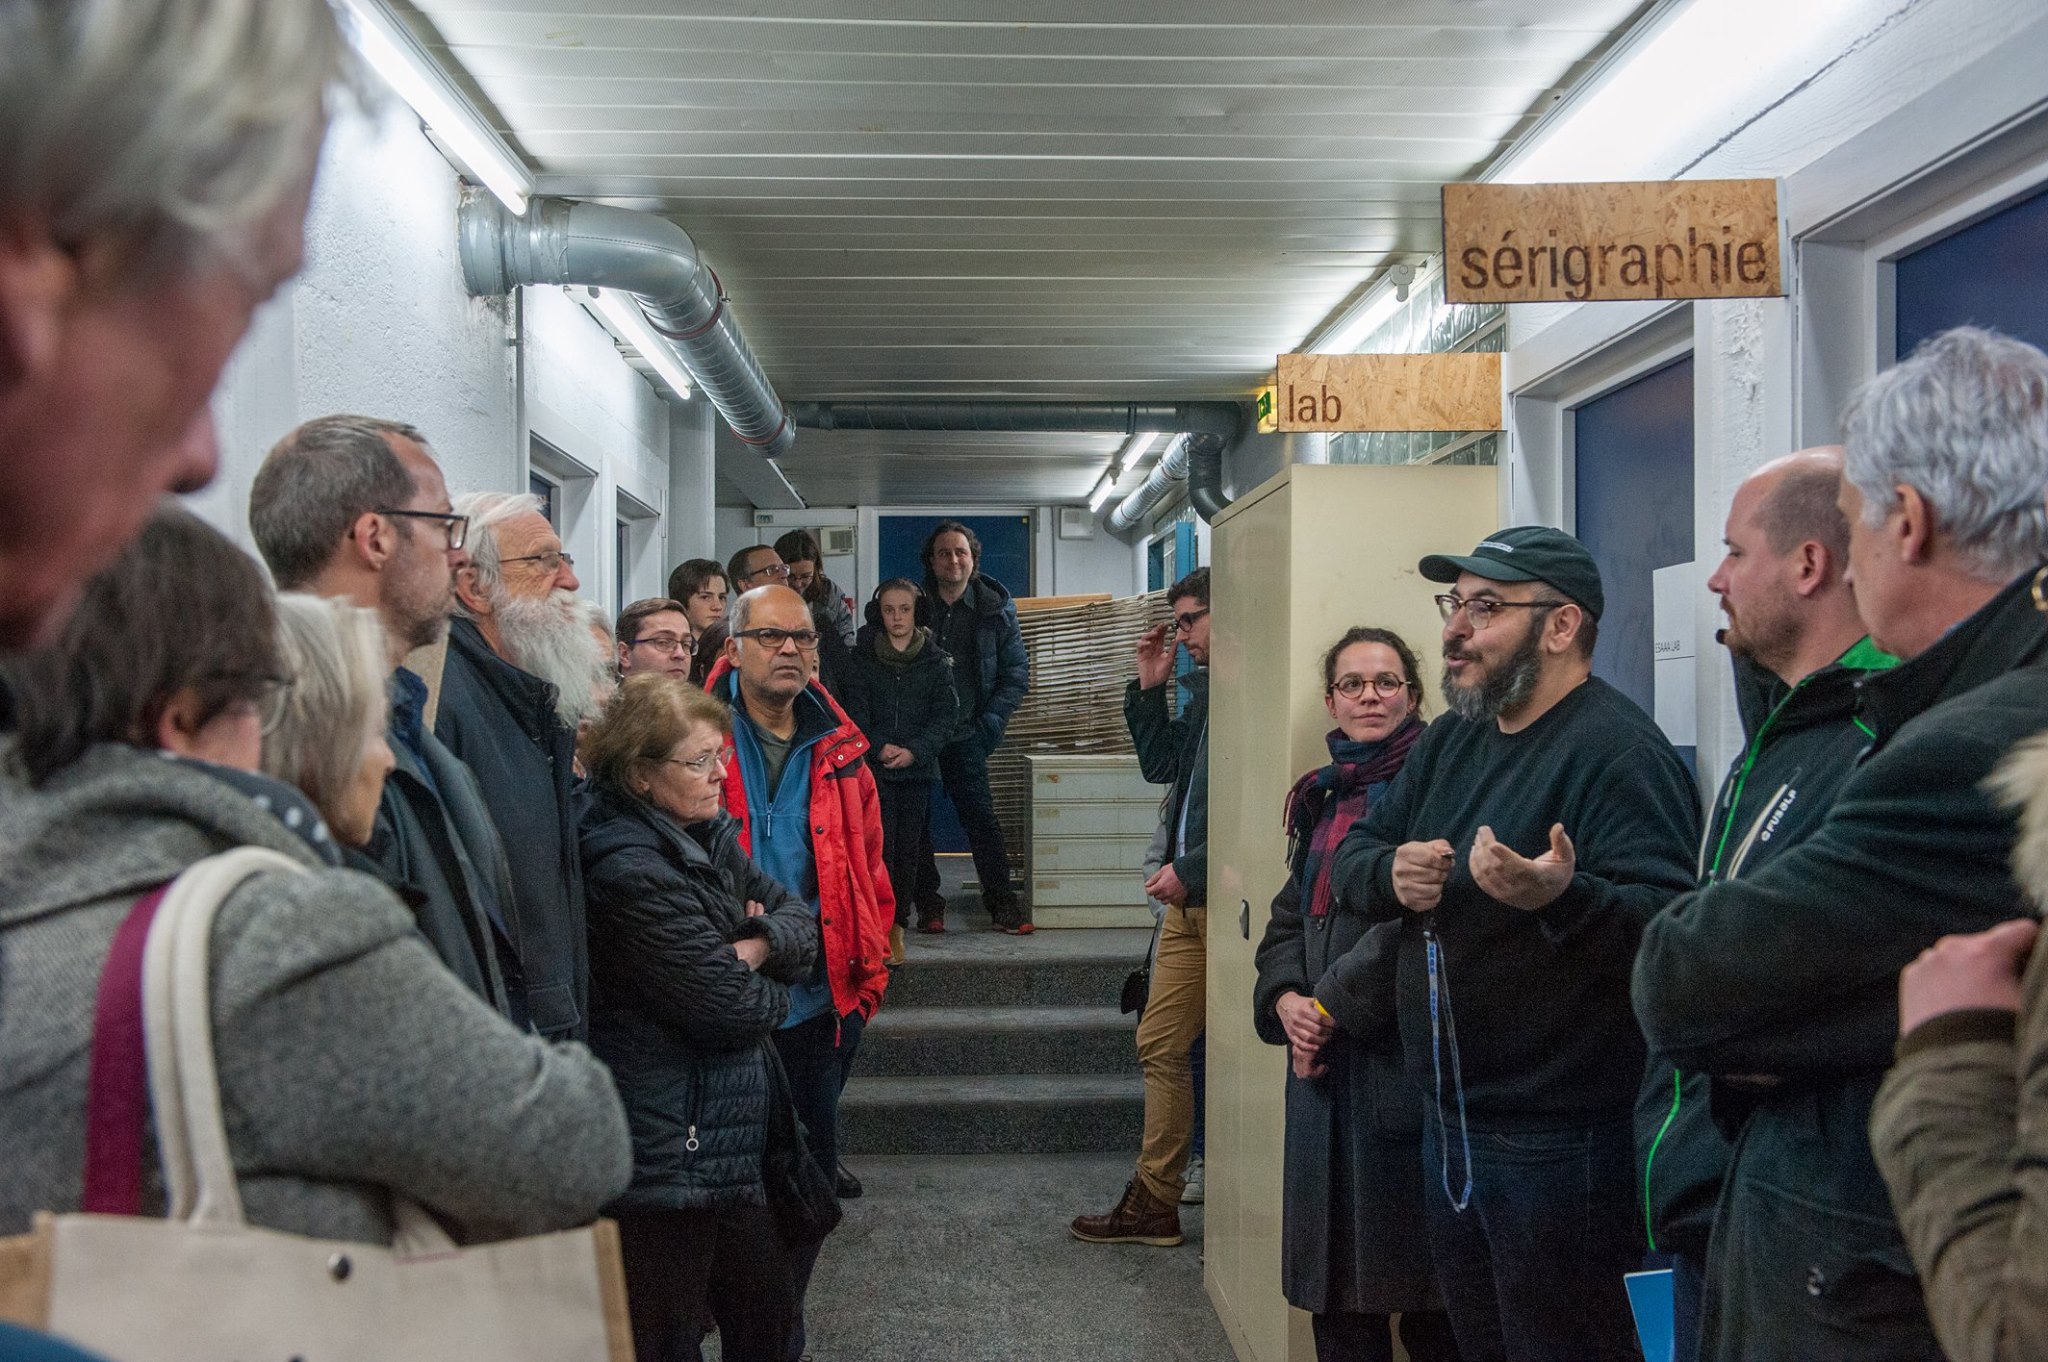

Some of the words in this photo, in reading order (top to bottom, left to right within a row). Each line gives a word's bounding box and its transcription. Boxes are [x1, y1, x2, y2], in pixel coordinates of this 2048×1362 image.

[1460, 226, 1767, 299] sérigraphie
[1288, 384, 1342, 423] lab
[1671, 639, 1680, 652] LAB
